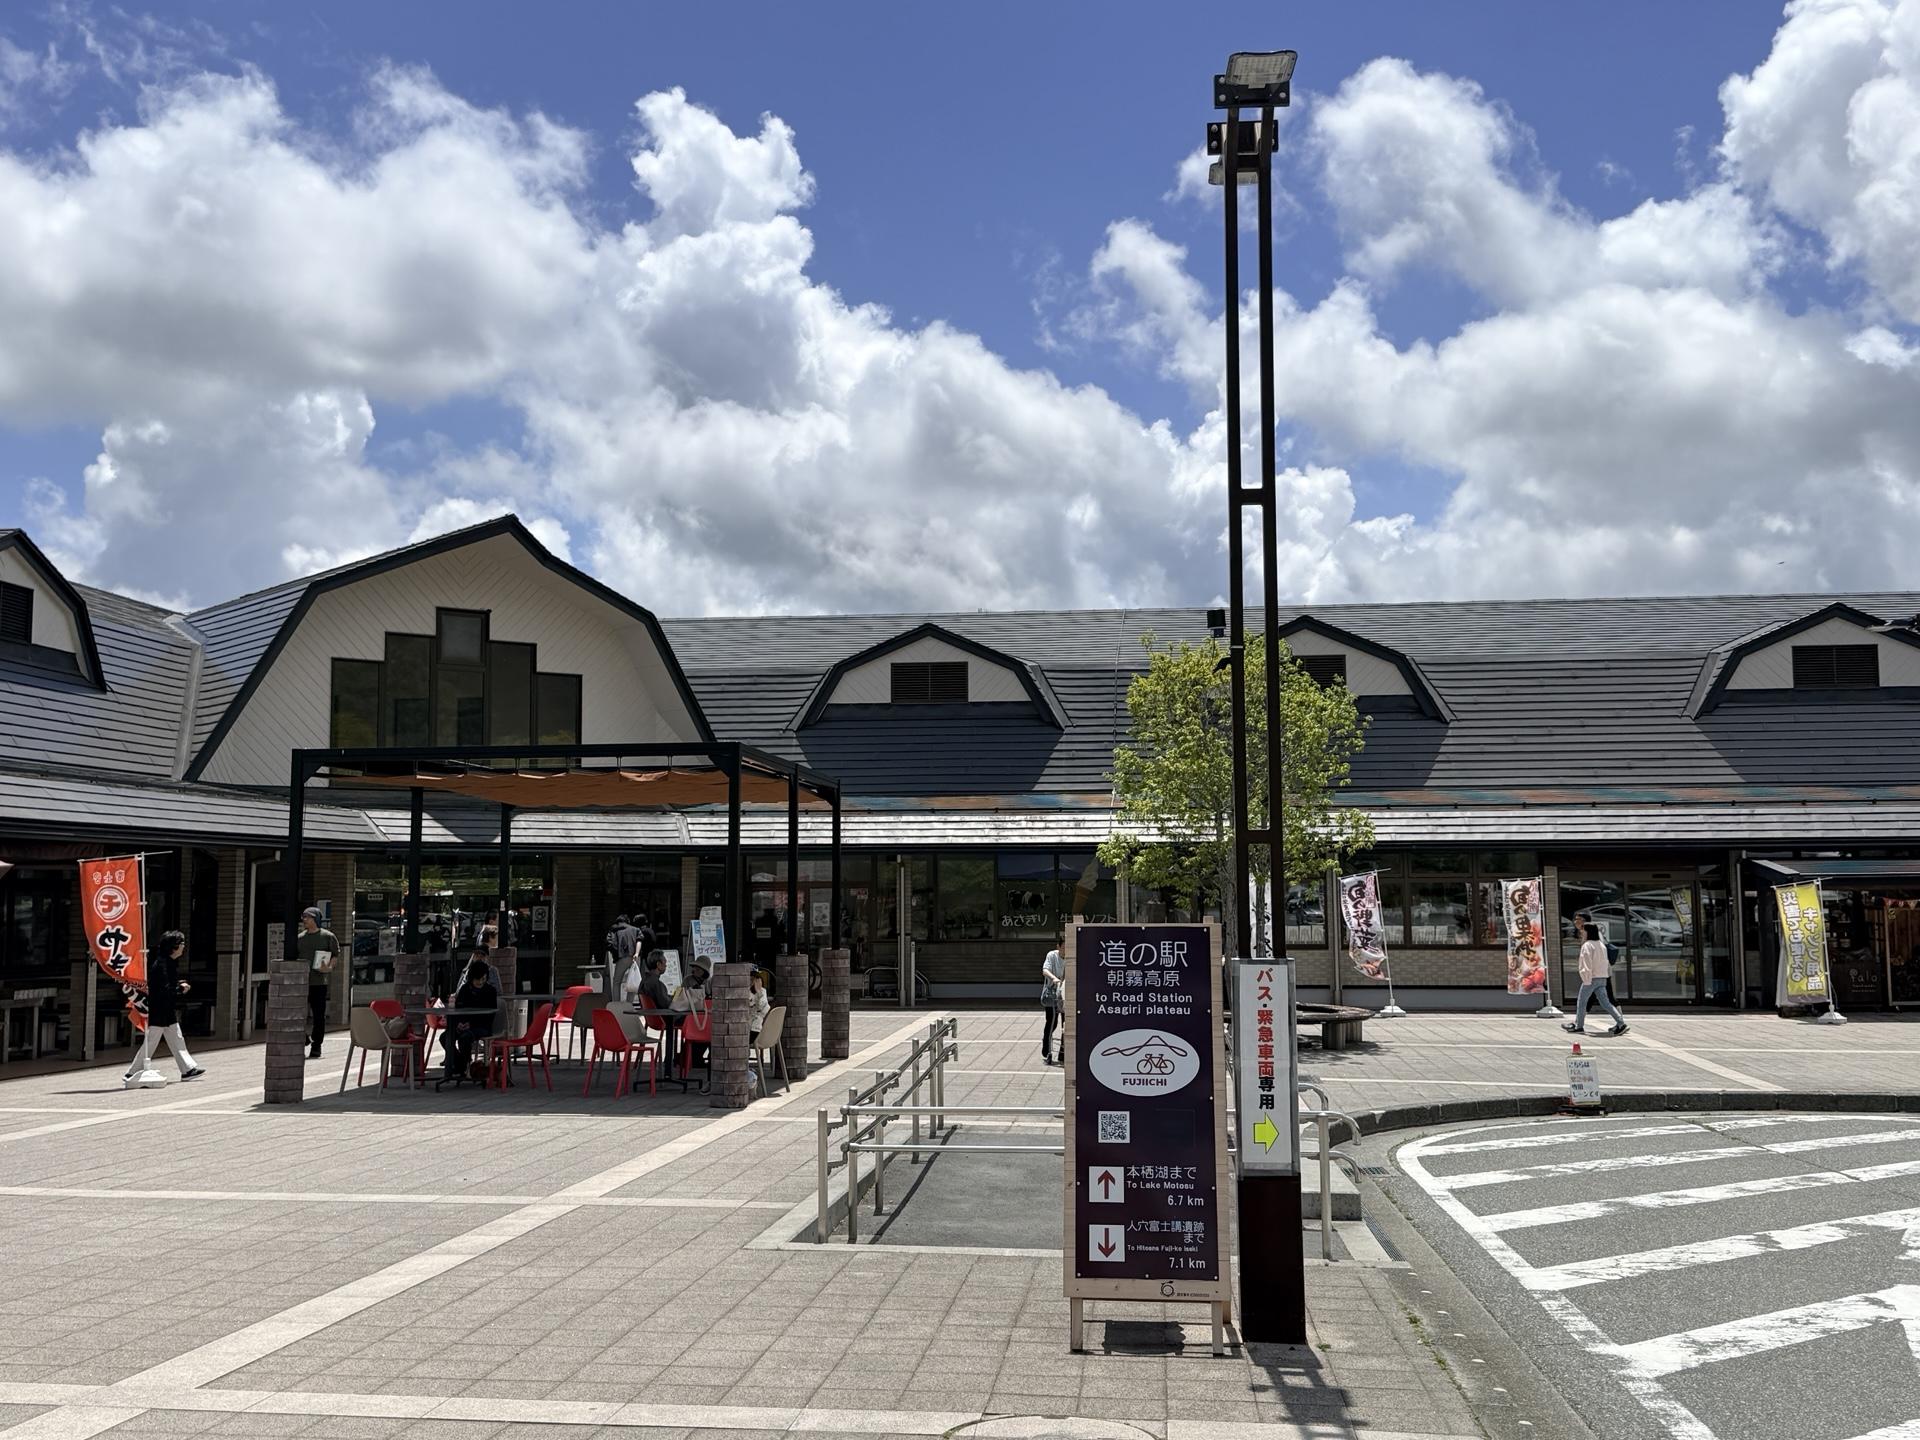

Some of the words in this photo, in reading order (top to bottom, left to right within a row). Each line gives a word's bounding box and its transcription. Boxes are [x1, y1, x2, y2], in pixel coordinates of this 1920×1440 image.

[1001, 914, 1048, 926] あさぎり
[1060, 914, 1117, 923] 生ソフト
[1099, 940, 1188, 967] 道の駅
[1107, 970, 1180, 987] 朝霧高原
[1095, 992, 1107, 1002] to
[1112, 992, 1143, 1002] Road
[1148, 992, 1192, 1003] Station
[1097, 1004, 1141, 1015] Asagiri
[1146, 1005, 1191, 1015] plateau
[1257, 967, 1275, 1110] バス・緊急車両専用
[1122, 1078, 1167, 1086] FUJIICHI
[1126, 1165, 1197, 1179] 本栖湖まで
[1140, 1181, 1160, 1189] Lake
[1163, 1181, 1194, 1190] Motosu
[1167, 1195, 1183, 1206] 6.7
[1187, 1195, 1204, 1206] km
[1126, 1220, 1205, 1232] 人穴富士講遺跡
[1183, 1233, 1205, 1244] まで
[1169, 1257, 1184, 1268] 7.1
[1189, 1257, 1206, 1269] km
